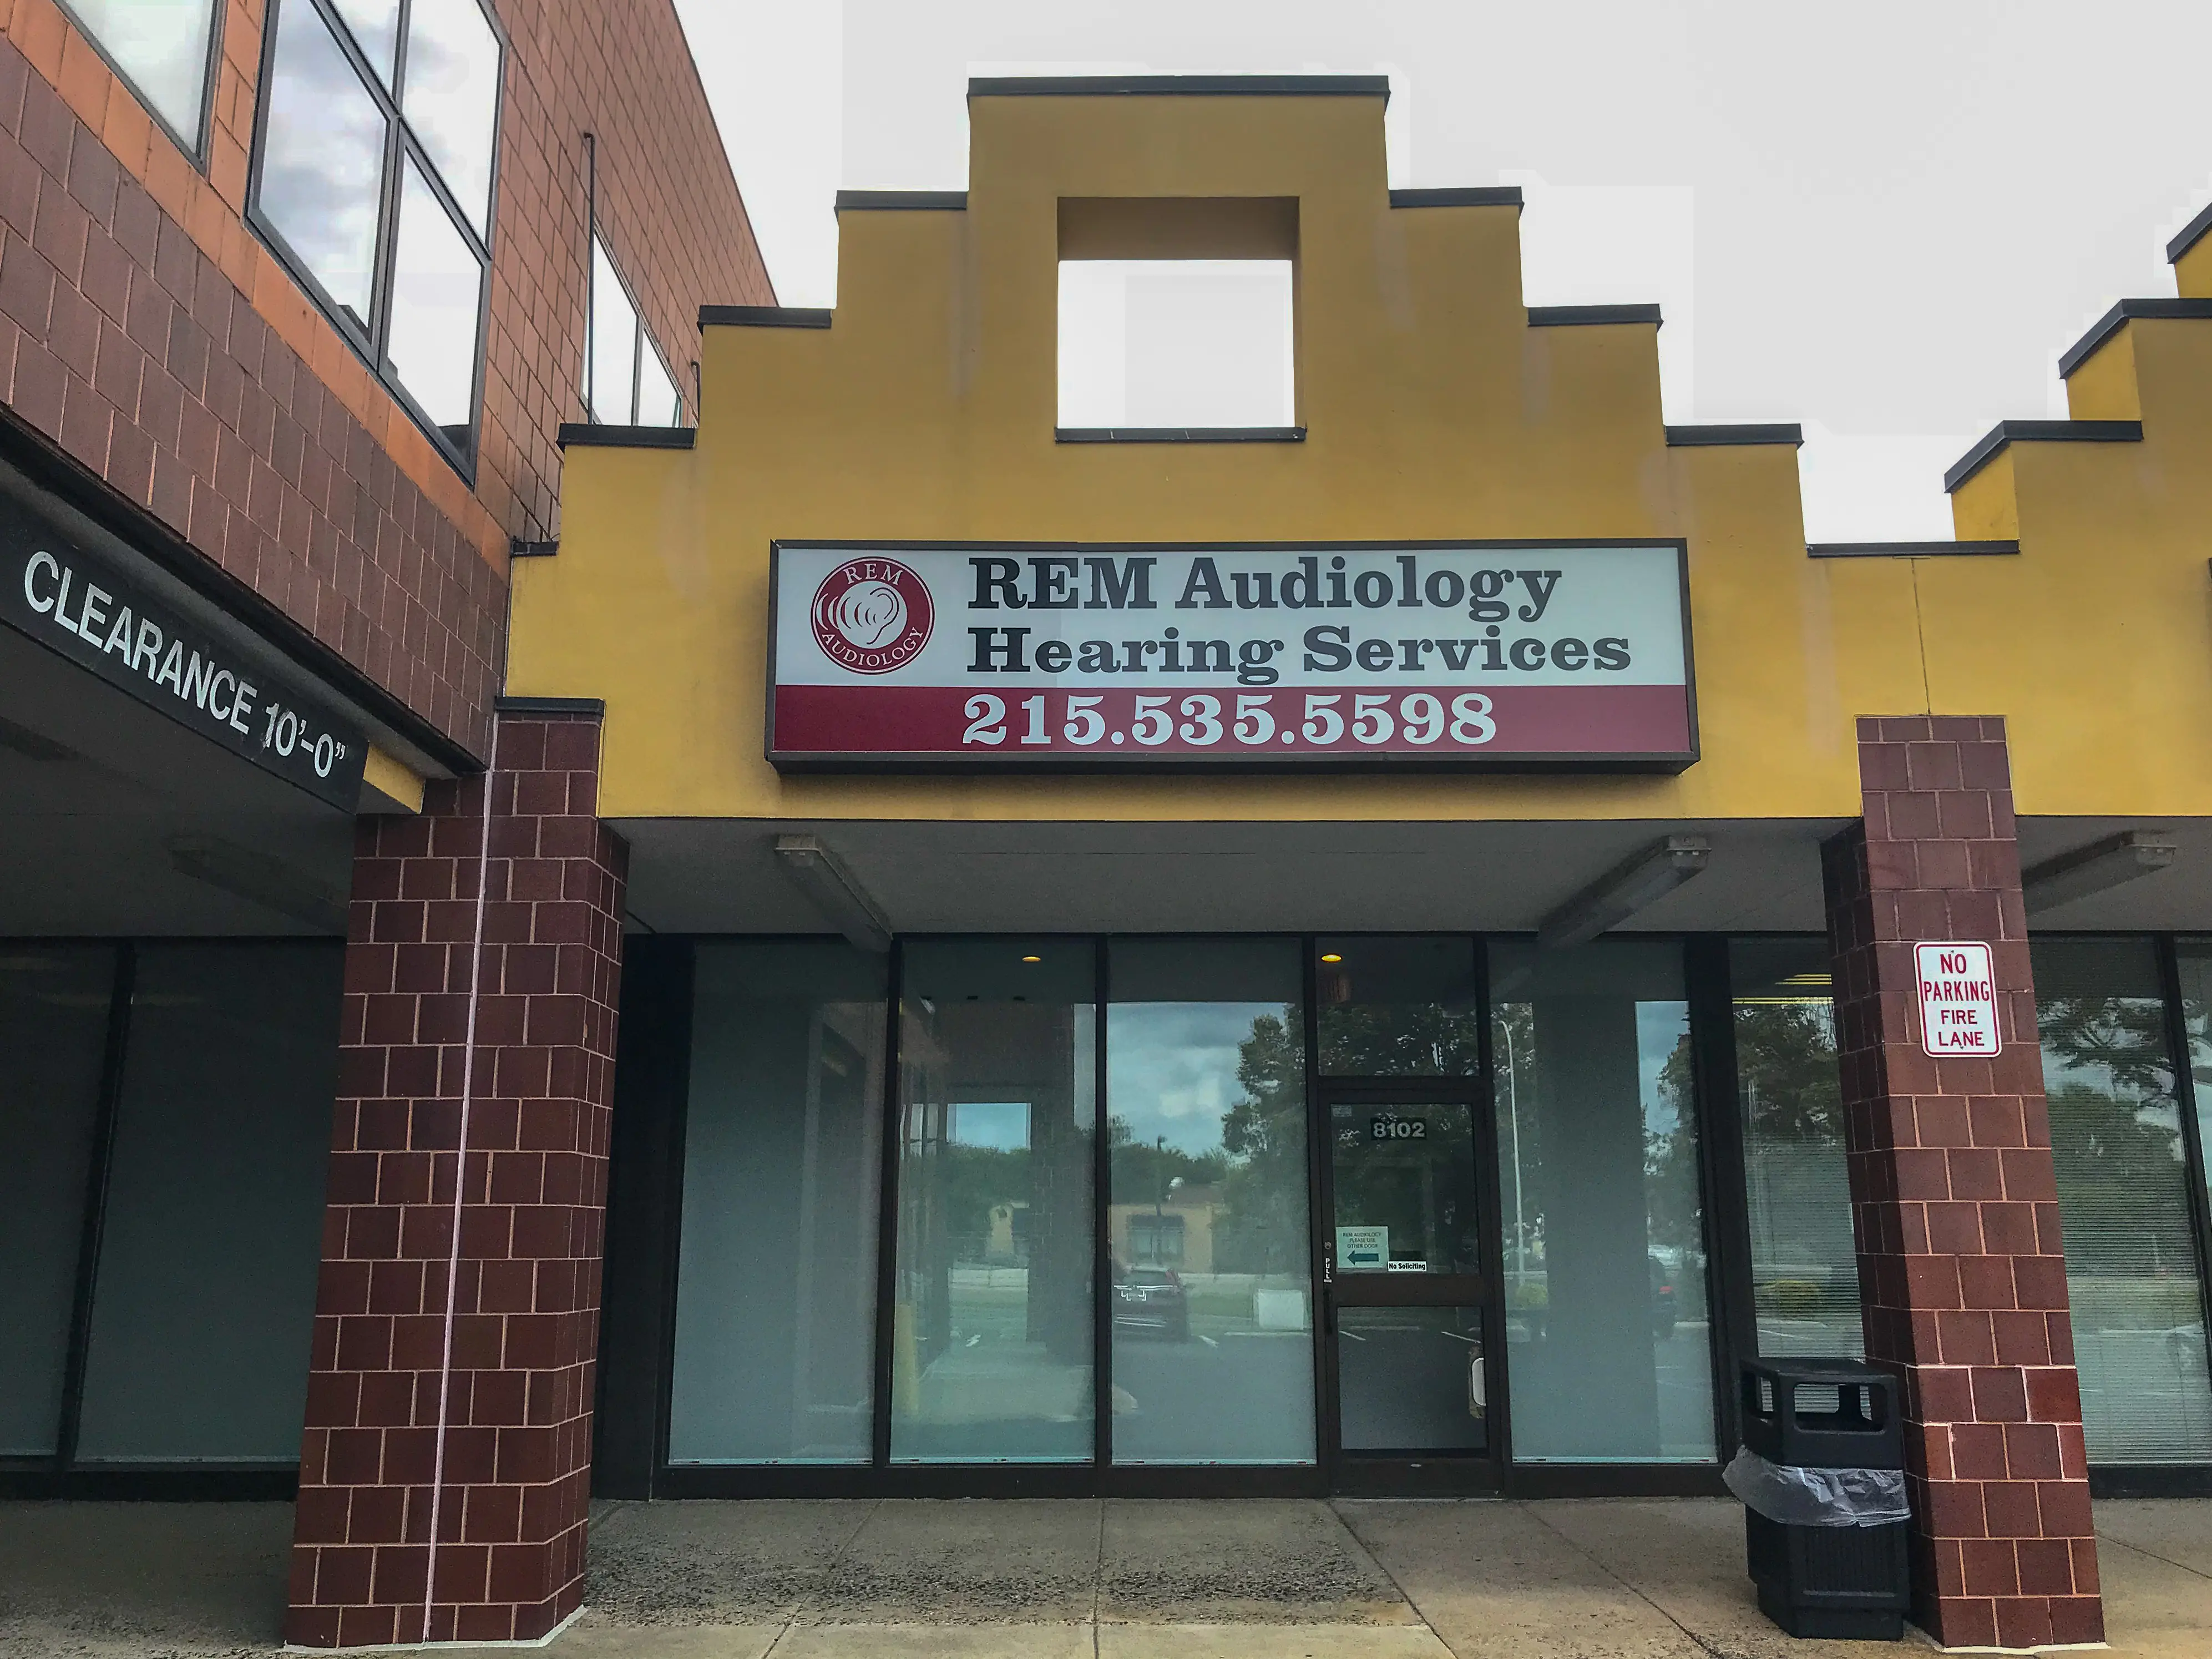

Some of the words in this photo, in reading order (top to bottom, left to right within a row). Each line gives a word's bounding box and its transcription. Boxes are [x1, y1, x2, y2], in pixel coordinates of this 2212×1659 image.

[843, 563, 903, 585] REM
[968, 557, 1157, 611] REM
[1175, 555, 1562, 623] Audiology
[24, 551, 257, 734] CLEARANCE
[822, 626, 923, 667] AUDIOLOGY
[968, 626, 1284, 686] Hearing
[1302, 624, 1632, 672] Services
[961, 692, 1498, 746] 215.535.5598
[1940, 954, 1967, 974] NO
[1923, 981, 1990, 1002] PARKING
[1941, 1010, 1978, 1024] FIRE
[1938, 1031, 1985, 1046] LANE
[1373, 1122, 1425, 1138] 8102
